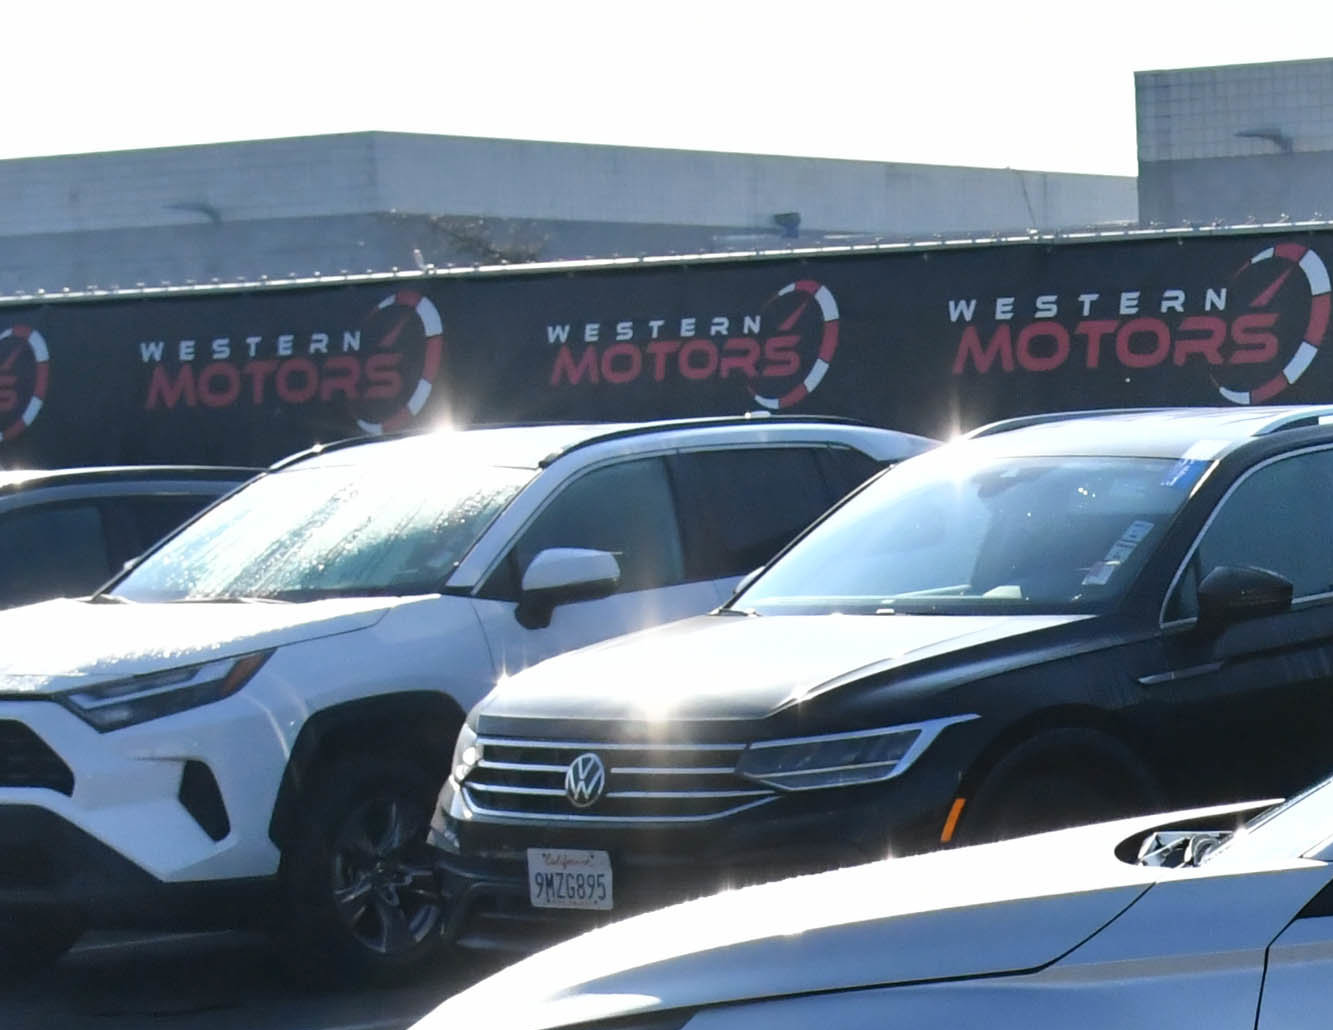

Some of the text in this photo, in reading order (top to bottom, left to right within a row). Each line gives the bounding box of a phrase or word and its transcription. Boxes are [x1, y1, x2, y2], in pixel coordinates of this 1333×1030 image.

[947, 286, 1228, 323] WESTERN
[140, 330, 362, 363] WESTERN
[546, 314, 762, 345] WESTERN
[954, 313, 1279, 374] MOTORS
[550, 334, 802, 387] MOTORS
[146, 352, 402, 410] MOTORS
[534, 872, 607, 901] 9MZG895
